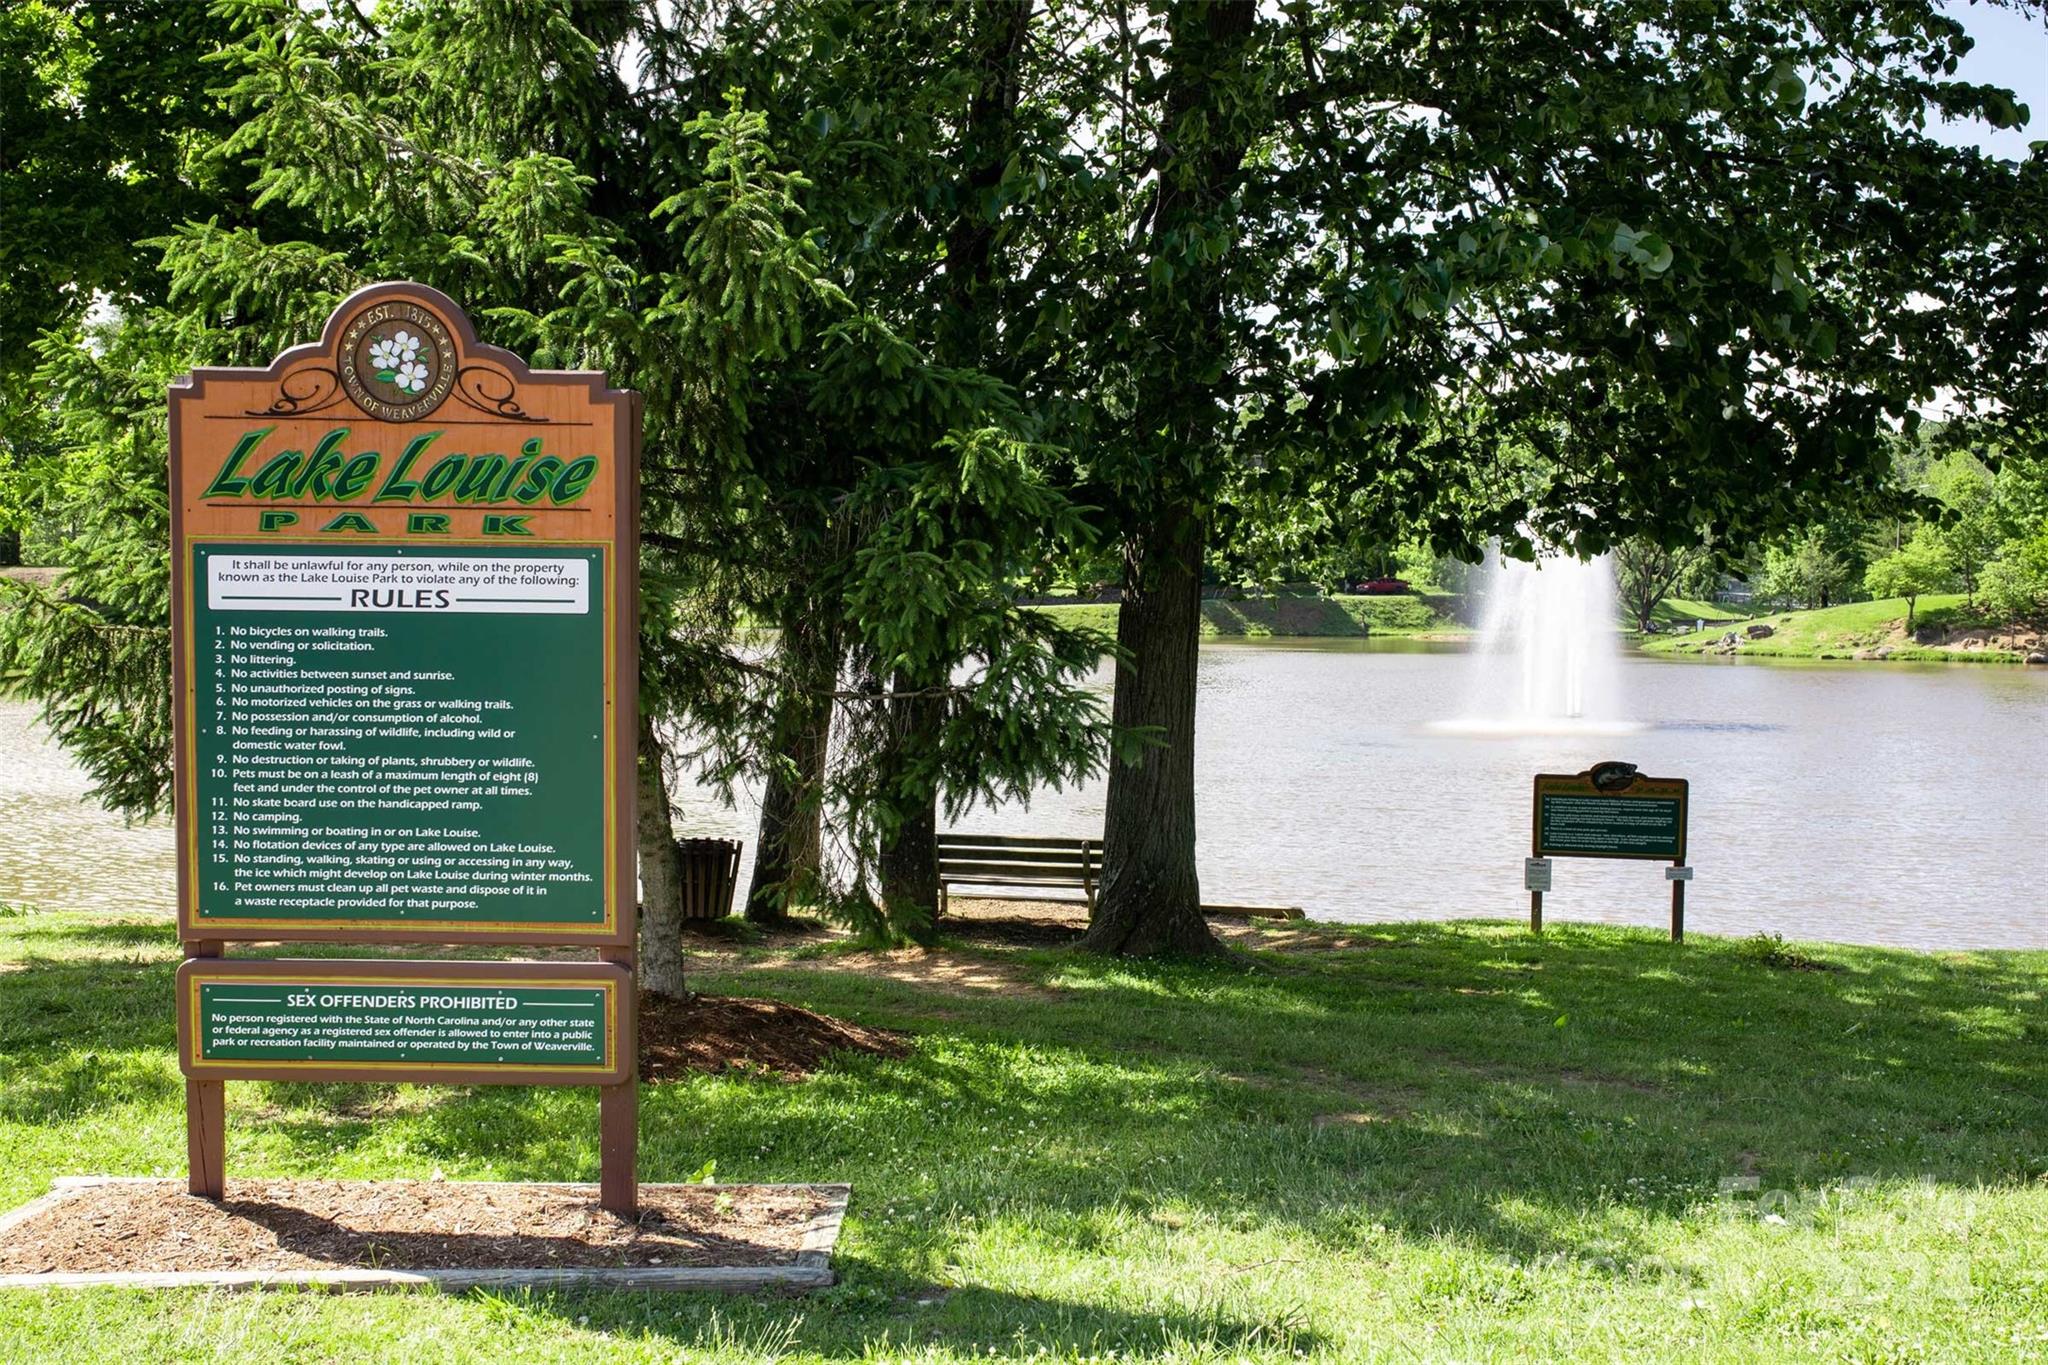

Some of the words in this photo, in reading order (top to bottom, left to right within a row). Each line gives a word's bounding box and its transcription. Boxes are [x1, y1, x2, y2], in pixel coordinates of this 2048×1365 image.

[367, 305, 394, 325] EST.
[344, 356, 366, 398] TOWN
[364, 396, 379, 411] OF
[382, 364, 452, 419] WEAVERVILLE
[200, 425, 381, 504] Lake
[371, 430, 599, 505] Louise
[258, 511, 534, 536] PARK
[232, 559, 240, 569] It
[243, 559, 270, 569] shall
[273, 560, 288, 570] be
[291, 560, 343, 570] unlawful
[346, 560, 363, 570] for
[366, 563, 388, 574] any
[391, 563, 433, 573] person,
[437, 561, 470, 572] while
[472, 564, 488, 572] on
[491, 562, 510, 572] the
[513, 564, 564, 575] property
[218, 571, 259, 582] known
[262, 574, 275, 582] as
[278, 572, 297, 582] the
[301, 572, 328, 582] Lake
[331, 573, 369, 583] Louise
[372, 571, 397, 583] Park
[401, 574, 413, 583] to
[416, 574, 455, 584] violate
[458, 576, 480, 587] any
[482, 574, 495, 584] of
[498, 573, 517, 584] the
[520, 573, 579, 588] following:
[350, 588, 451, 609] RULES
[216, 625, 224, 635] 1.
[230, 626, 247, 635] No
[249, 626, 292, 638] bicycles
[294, 628, 309, 636] on
[311, 627, 356, 639] walking
[358, 627, 388, 637] trails.
[214, 639, 224, 649] 2.
[230, 639, 247, 649] No
[249, 640, 294, 652] vending
[297, 642, 309, 650] or
[311, 640, 374, 651] solicitation.
[215, 653, 225, 663] 3.
[230, 654, 247, 664] No
[249, 654, 296, 667] littering.
[215, 668, 225, 677] 4.
[231, 668, 247, 678] No
[249, 668, 298, 678] activities
[300, 669, 349, 679] between
[351, 670, 387, 679] sunset
[389, 670, 411, 679] and
[413, 670, 454, 680] sunrise.
[215, 683, 225, 692] 5.
[231, 683, 248, 693] No
[250, 683, 324, 693] unauthorized
[326, 684, 368, 696] posting
[370, 684, 383, 694] of
[384, 684, 415, 697] signs.
[216, 711, 226, 720] 7.
[231, 711, 248, 721] No
[250, 712, 309, 723] possession
[311, 712, 350, 724] and/or
[352, 713, 423, 724] consumption
[425, 713, 437, 723] of
[439, 713, 482, 723] alcohol.
[216, 725, 226, 734] 8.
[232, 725, 248, 735] No
[250, 725, 292, 738] feeding
[309, 726, 362, 738] harassing
[364, 726, 377, 736] of
[378, 727, 421, 737] wildlife,
[424, 727, 475, 740] including
[477, 728, 501, 738] wild
[503, 730, 515, 738] or
[232, 739, 281, 750] domestic
[283, 741, 316, 750] water
[318, 740, 346, 750] fowl.
[212, 797, 227, 806] 11.
[233, 797, 249, 806] No
[252, 797, 281, 807] skate
[283, 798, 316, 807] board
[318, 799, 337, 807] use
[339, 800, 354, 808] on
[357, 798, 376, 808] the
[378, 798, 449, 811] handicapped
[451, 801, 482, 811] ramp.
[212, 811, 227, 821] 12.
[233, 811, 249, 821] No
[251, 811, 302, 824] camping.
[212, 825, 228, 834] 13.
[233, 825, 250, 835] No
[252, 825, 308, 838] swimming
[311, 827, 323, 835] or
[325, 826, 368, 838] boating
[370, 826, 381, 836] in
[383, 828, 396, 836] or
[397, 828, 413, 836] on
[415, 827, 441, 837] Lake
[443, 827, 480, 837] Louise.
[234, 867, 253, 877] the
[255, 867, 270, 877] ice
[272, 868, 306, 877] which
[309, 868, 341, 880] might
[343, 868, 387, 881] develop
[406, 869, 432, 879] Lake
[434, 870, 469, 880] Louise
[471, 870, 508, 883] during
[510, 871, 546, 881] winter
[548, 871, 592, 882] months.
[234, 897, 241, 905] a
[244, 897, 277, 906] waste
[279, 897, 335, 908] receptacle
[337, 897, 386, 909] provided
[388, 897, 404, 907] for
[406, 898, 429, 907] that
[431, 900, 478, 910] purpose.
[287, 994, 315, 1006] SEX
[320, 994, 415, 1008] OFFENDERS
[420, 996, 517, 1009] PROHIBITED
[211, 1013, 227, 1022] No
[229, 1015, 264, 1024] person
[266, 1014, 317, 1025] registered
[319, 1014, 343, 1023] with
[345, 1015, 362, 1023] the
[364, 1015, 390, 1024] State
[391, 1015, 403, 1024] of
[404, 1015, 435, 1024] North
[437, 1016, 479, 1025] Carolina
[481, 1017, 517, 1027] and/or
[518, 1019, 537, 1028] any
[539, 1018, 567, 1027] other
[569, 1019, 594, 1027] state
[212, 1037, 235, 1047] park
[237, 1038, 248, 1046] or
[250, 1037, 301, 1046] recreation
[303, 1038, 336, 1049] facility
[338, 1039, 394, 1048] maintained
[396, 1040, 408, 1048] or
[409, 1040, 455, 1050] operated
[457, 1040, 470, 1051] by
[471, 1040, 488, 1049] the
[490, 1040, 519, 1049] Town
[521, 1041, 532, 1050] of
[533, 1041, 594, 1051] Weaverville.
